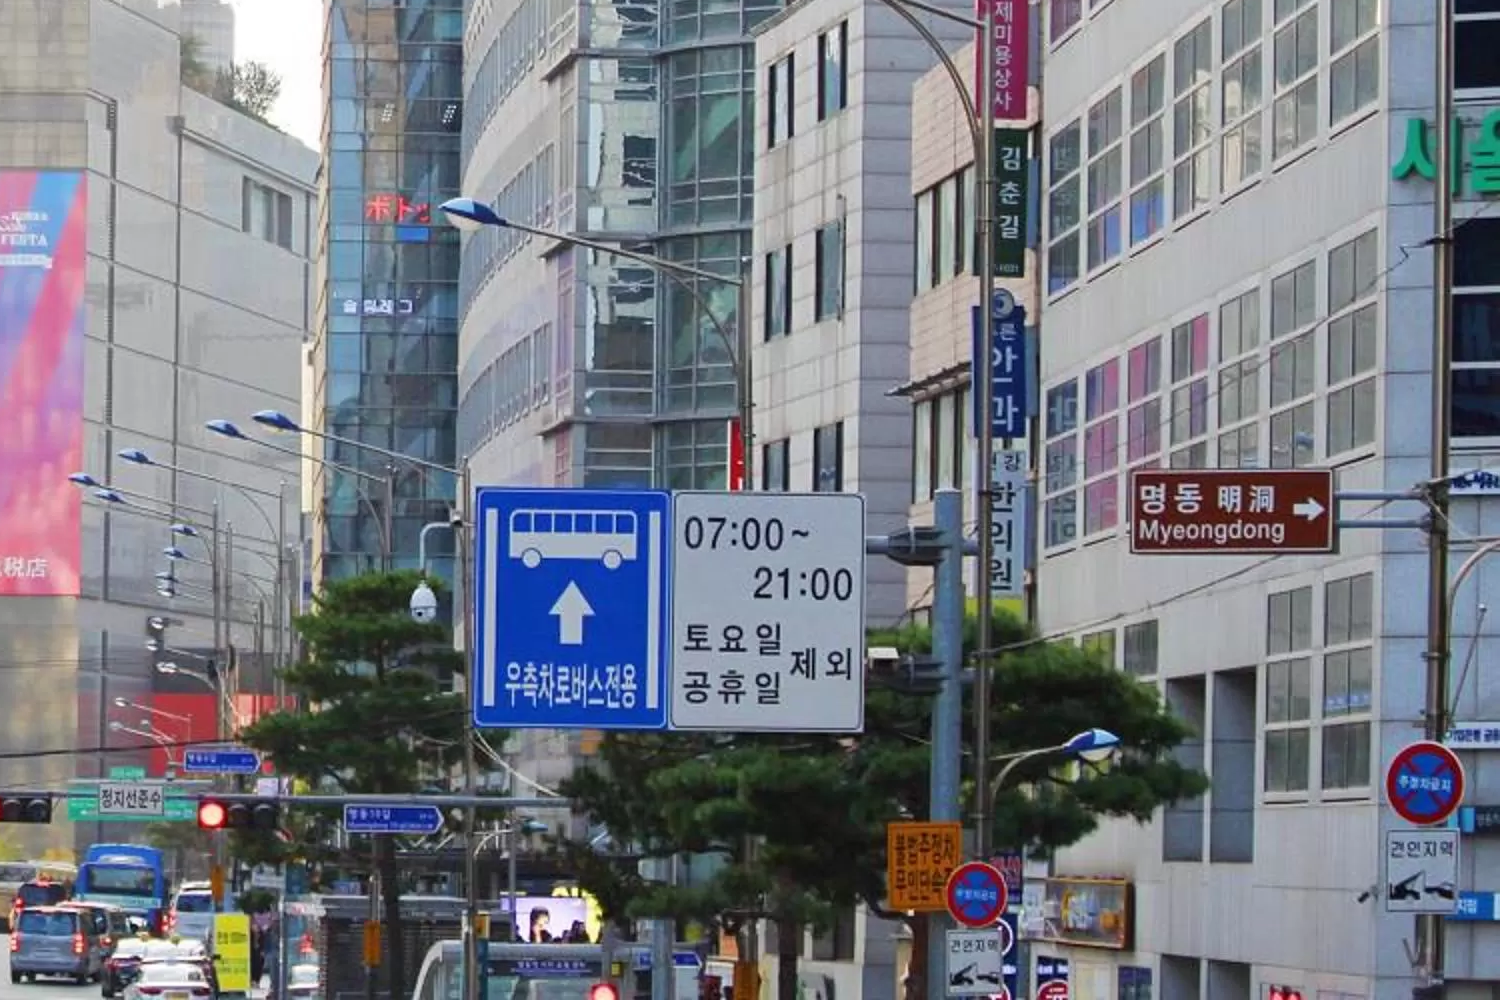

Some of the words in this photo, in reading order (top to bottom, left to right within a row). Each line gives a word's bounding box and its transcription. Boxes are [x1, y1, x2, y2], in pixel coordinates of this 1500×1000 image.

[999, 147, 1021, 240] 김춘길
[1140, 483, 1203, 514] 명동
[1217, 485, 1276, 514] 明洞
[1139, 519, 1286, 545] Myeongdong
[752, 566, 854, 601] 21:00
[683, 621, 782, 656] 토요일
[789, 647, 853, 681] 제외
[505, 661, 637, 709] 우측차로버스전용
[682, 669, 781, 705] 공휴일
[101, 786, 162, 810] 정지선준수
[1397, 774, 1452, 793] 주정차금지
[1390, 840, 1454, 858] 견인지역
